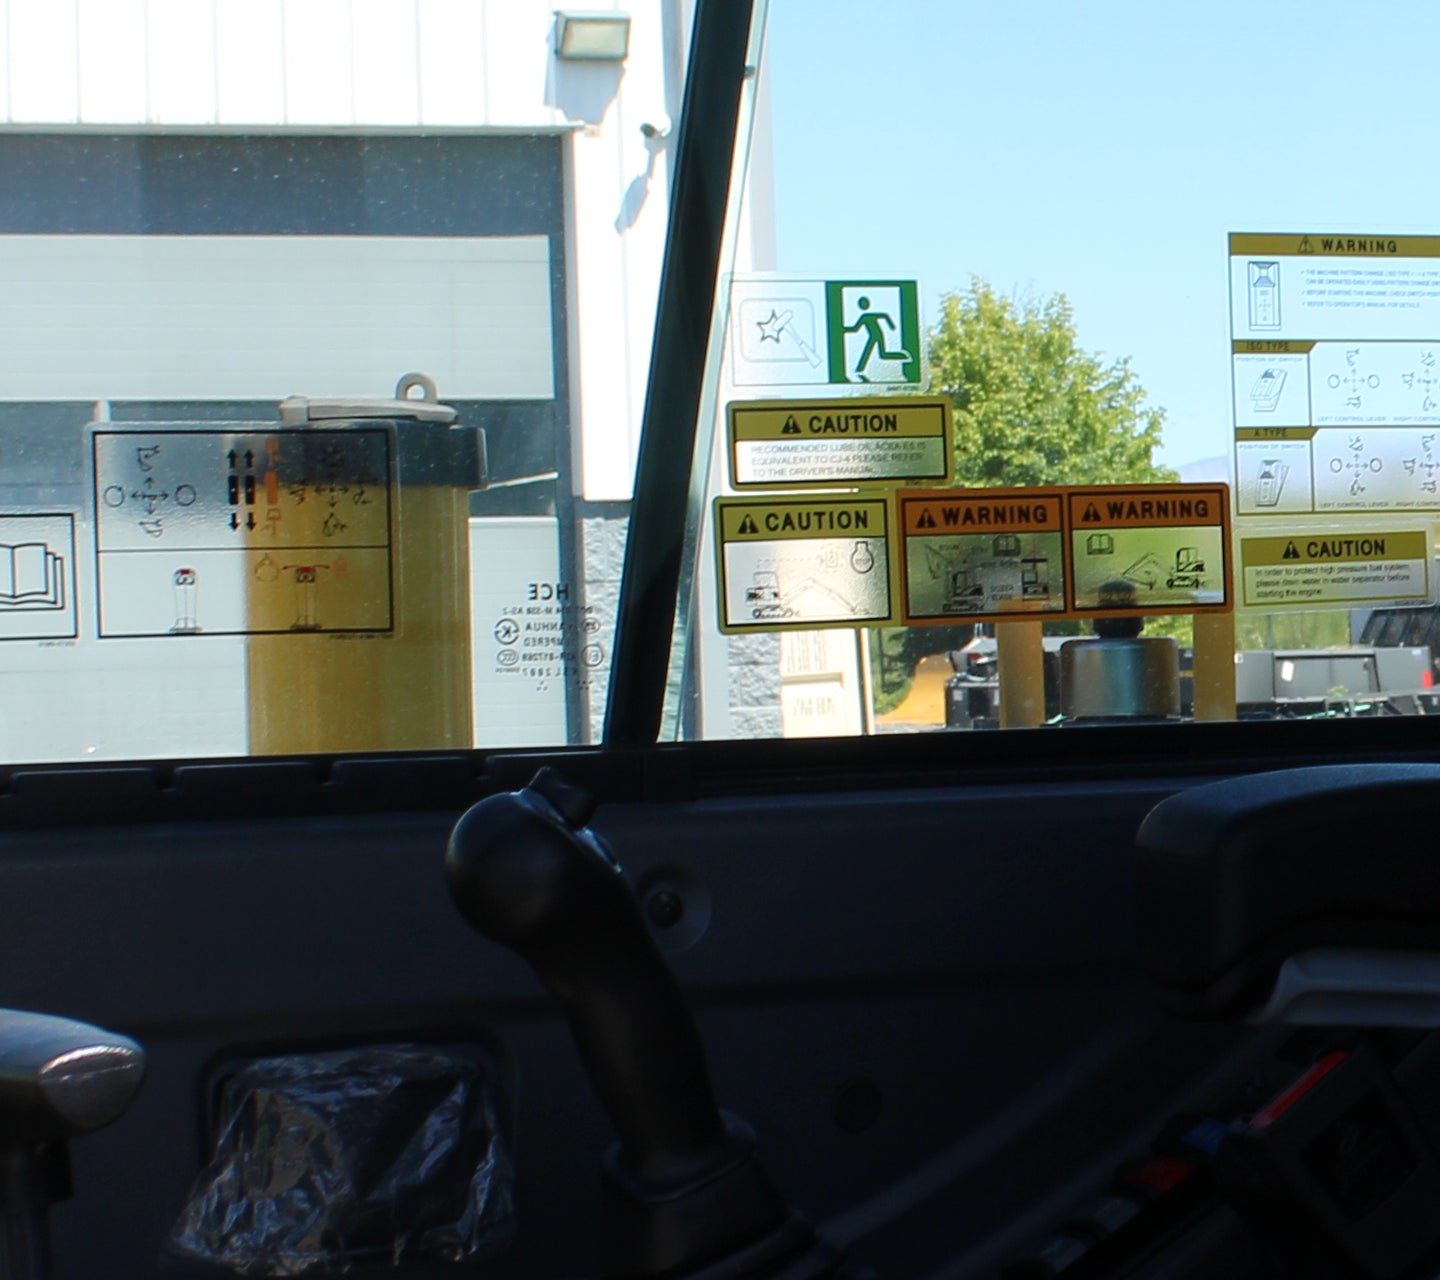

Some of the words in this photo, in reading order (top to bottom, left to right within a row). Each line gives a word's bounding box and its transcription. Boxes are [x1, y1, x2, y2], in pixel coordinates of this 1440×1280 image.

[1321, 239, 1398, 253] WARNING
[1266, 342, 1290, 351] TYPE
[808, 415, 897, 434] CAUTION
[1265, 428, 1288, 438] TYPE
[751, 444, 828, 455] RECOMMENDED
[752, 456, 812, 466] EQUIVALENT
[814, 456, 828, 464] TO
[753, 468, 766, 478] TO
[768, 468, 787, 478] THE
[942, 504, 1048, 526] WARNING
[1106, 499, 1209, 520] WARNING
[765, 510, 869, 532] CAUTION
[1306, 539, 1386, 558] CAUTION
[1264, 568, 1284, 576] order
[1256, 580, 1280, 588] please
[1387, 574, 1410, 582] before
[1256, 590, 1284, 598] starting
